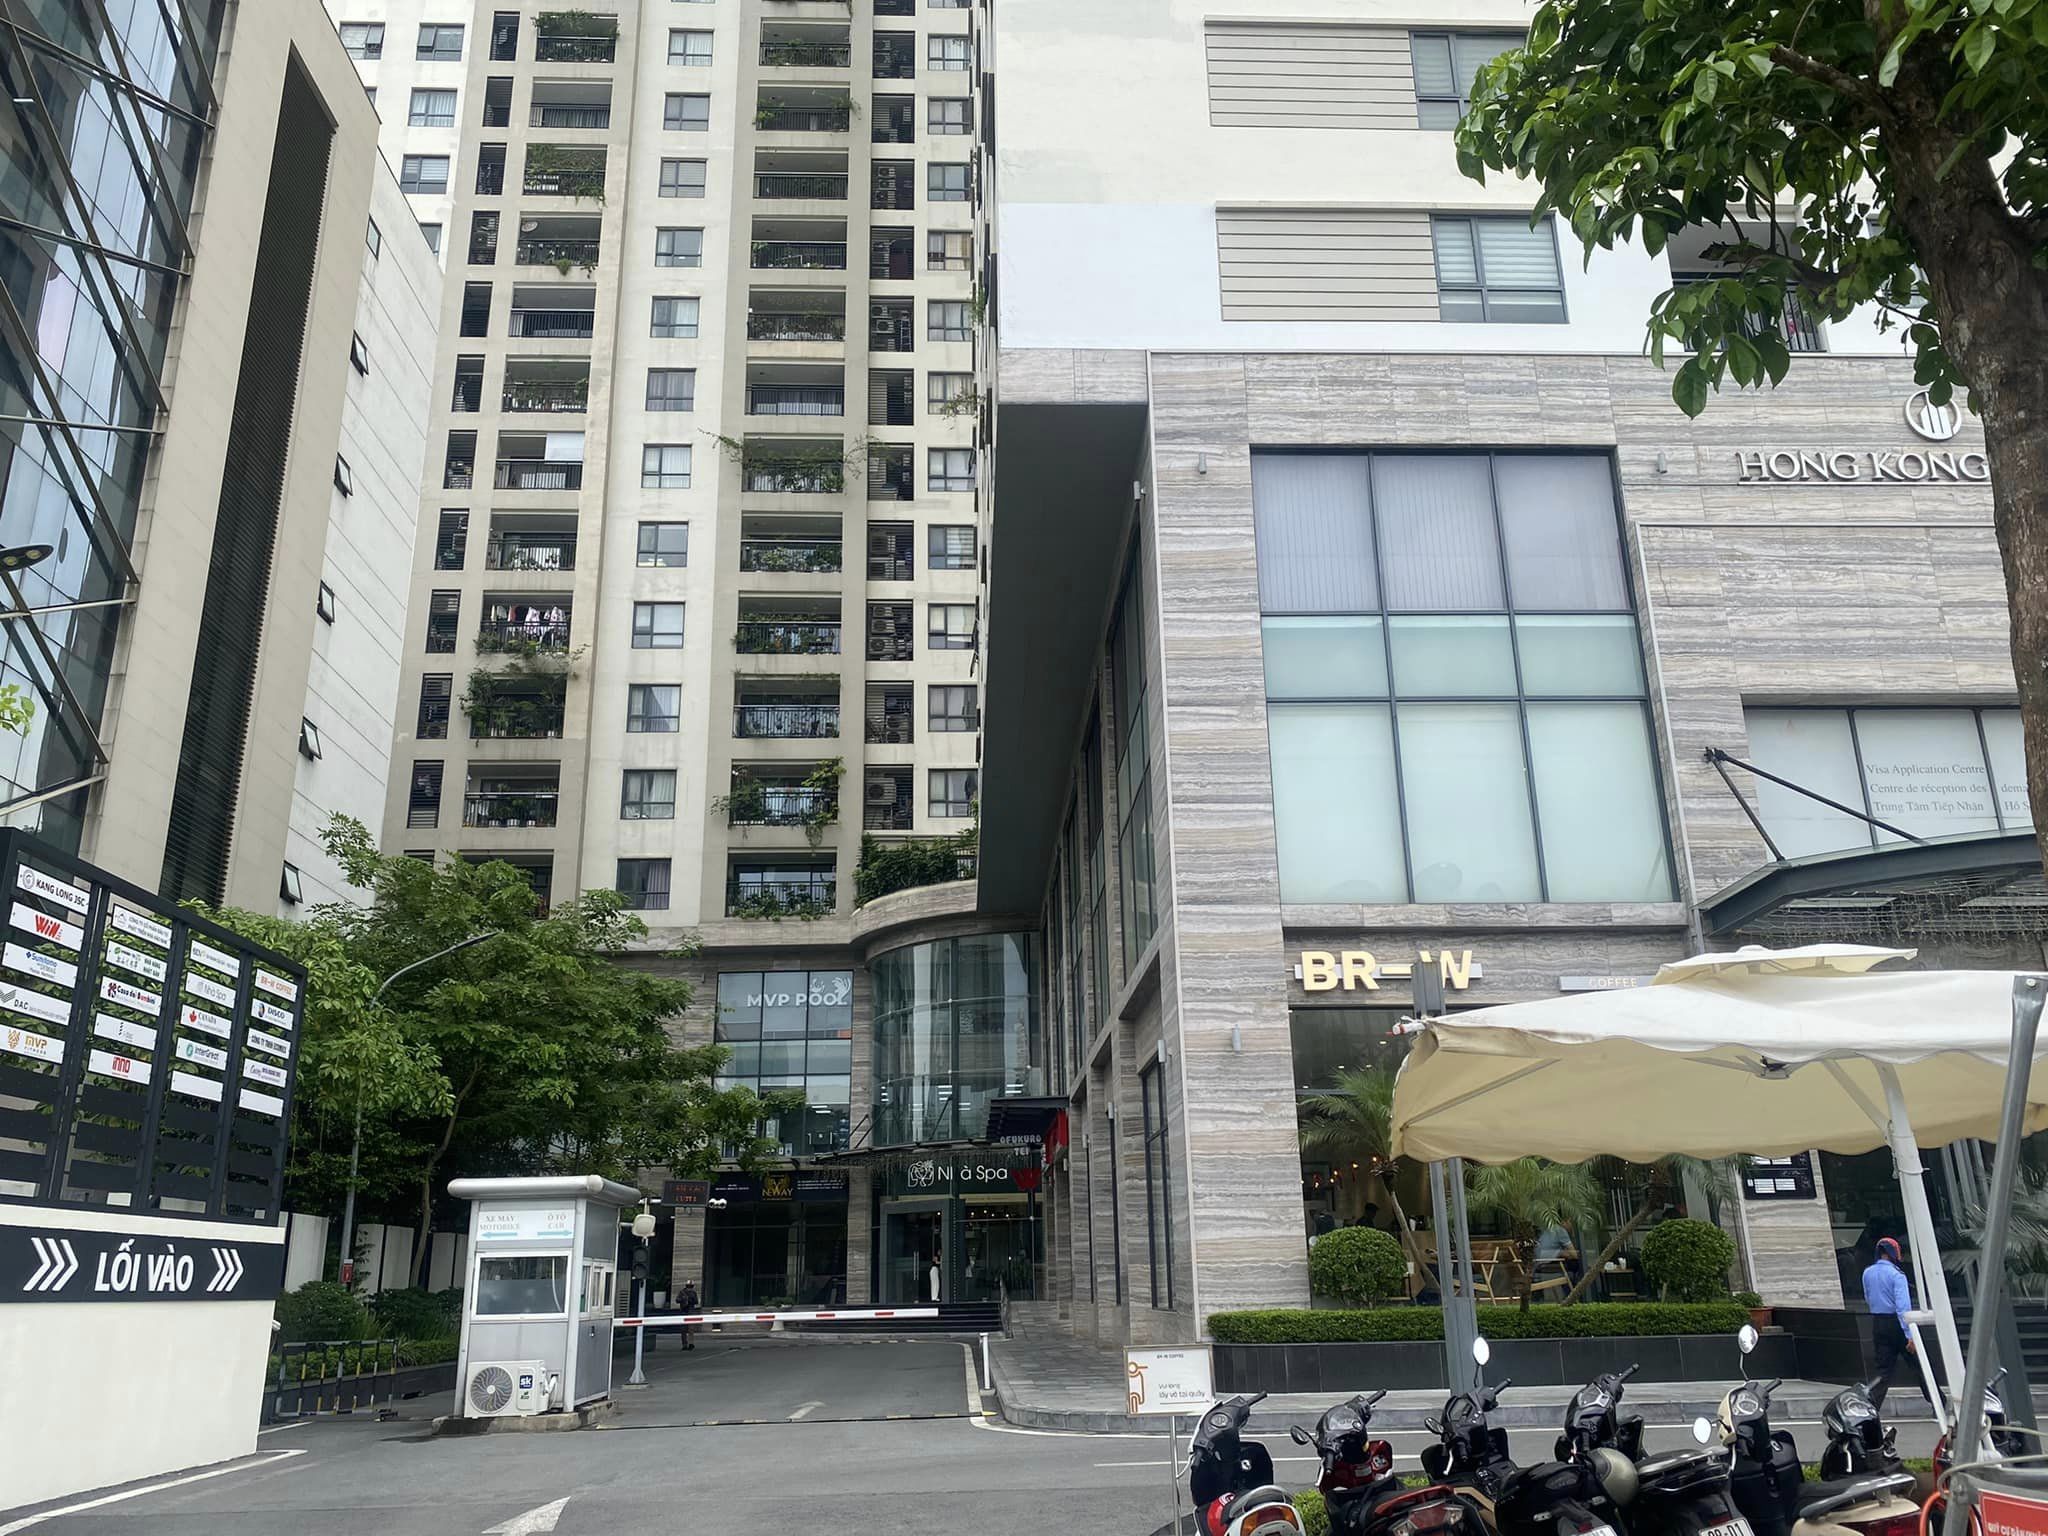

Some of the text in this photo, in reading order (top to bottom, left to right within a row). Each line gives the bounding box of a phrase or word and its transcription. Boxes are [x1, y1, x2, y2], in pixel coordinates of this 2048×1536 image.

[1735, 451, 1991, 482] HONG KONG
[1866, 764, 1985, 777] Visa Application Centre
[1870, 783, 2028, 795] Centre de réception des dema
[1874, 801, 1904, 814] Trung
[36, 879, 86, 908] KANG LONG JSC
[1588, 977, 1637, 987] COFFEE
[14, 999, 29, 1010] DAC
[747, 992, 848, 1007] MVP POOL
[25, 1035, 48, 1049] MVP
[1014, 1147, 1029, 1156] TEI
[976, 1165, 1008, 1183] Spa
[94, 1238, 195, 1293] LỐI VÀO
